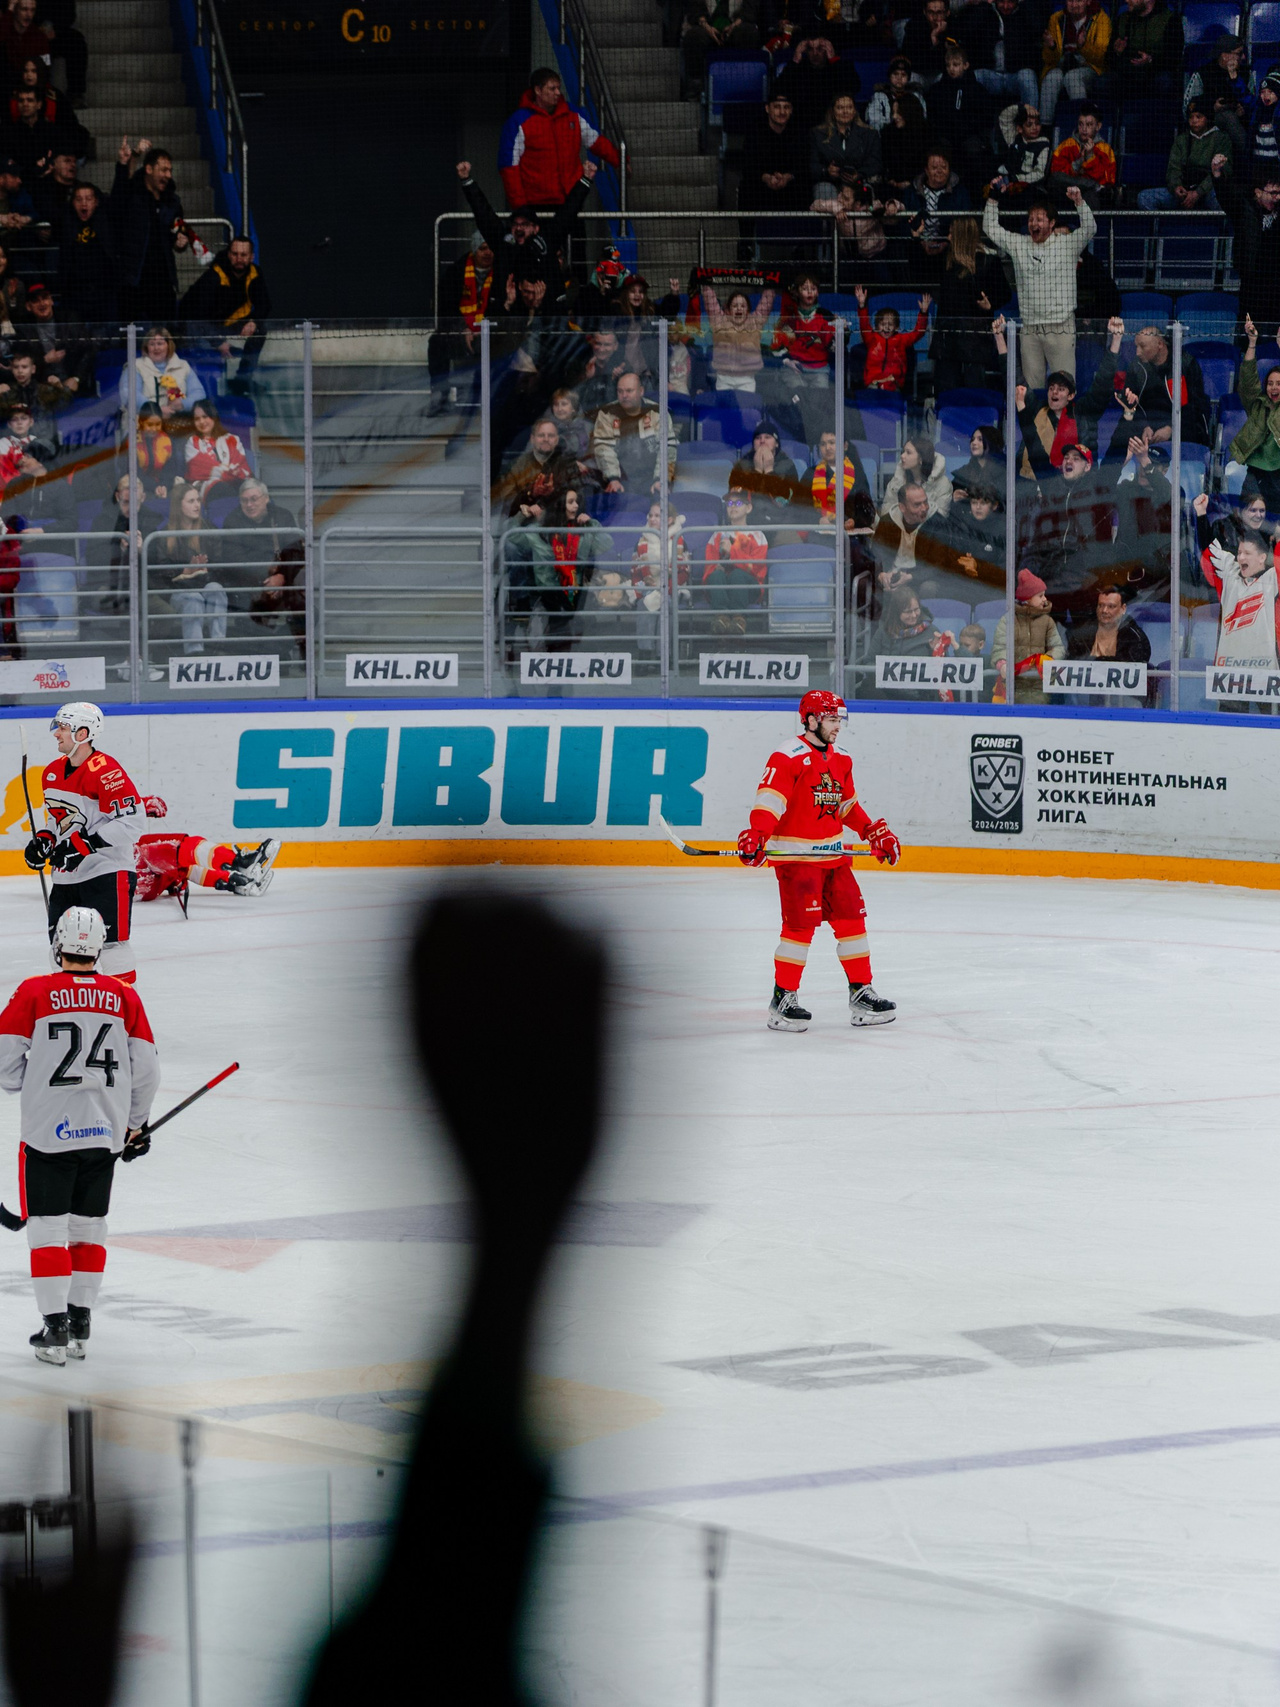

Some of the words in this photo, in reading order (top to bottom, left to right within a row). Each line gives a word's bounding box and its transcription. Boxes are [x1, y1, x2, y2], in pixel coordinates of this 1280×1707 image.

[372, 25, 391, 43] 10
[410, 20, 487, 31] SECTOR
[33, 673, 58, 682] АВТО
[176, 661, 273, 683] KHL.RU
[353, 660, 451, 680] KHL.RU
[527, 658, 625, 678] KHL.RU
[706, 660, 802, 681] KHL.RU
[882, 661, 977, 684] KHL.RU
[1049, 666, 1141, 689] KHL.RU
[39, 679, 71, 689] РАДИО
[1211, 672, 1280, 697] KHL.R
[974, 736, 1020, 749] FONBET
[1036, 749, 1115, 766] ФОНБЕТ
[233, 726, 709, 828] SIBUR
[977, 764, 989, 777] К
[1004, 765, 1017, 778] Л
[1036, 769, 1228, 791] КОНТИНЕНТАЛЬНАЯ
[110, 796, 137, 819] 13
[1036, 788, 1157, 807] ХОККЕЙНАЯ
[974, 820, 1020, 831] 2024/2025
[1036, 809, 1087, 824] ЛИГА
[75, 944, 87, 954] 24
[49, 987, 121, 1013] SOLOVYEV
[48, 1022, 119, 1088] 24
